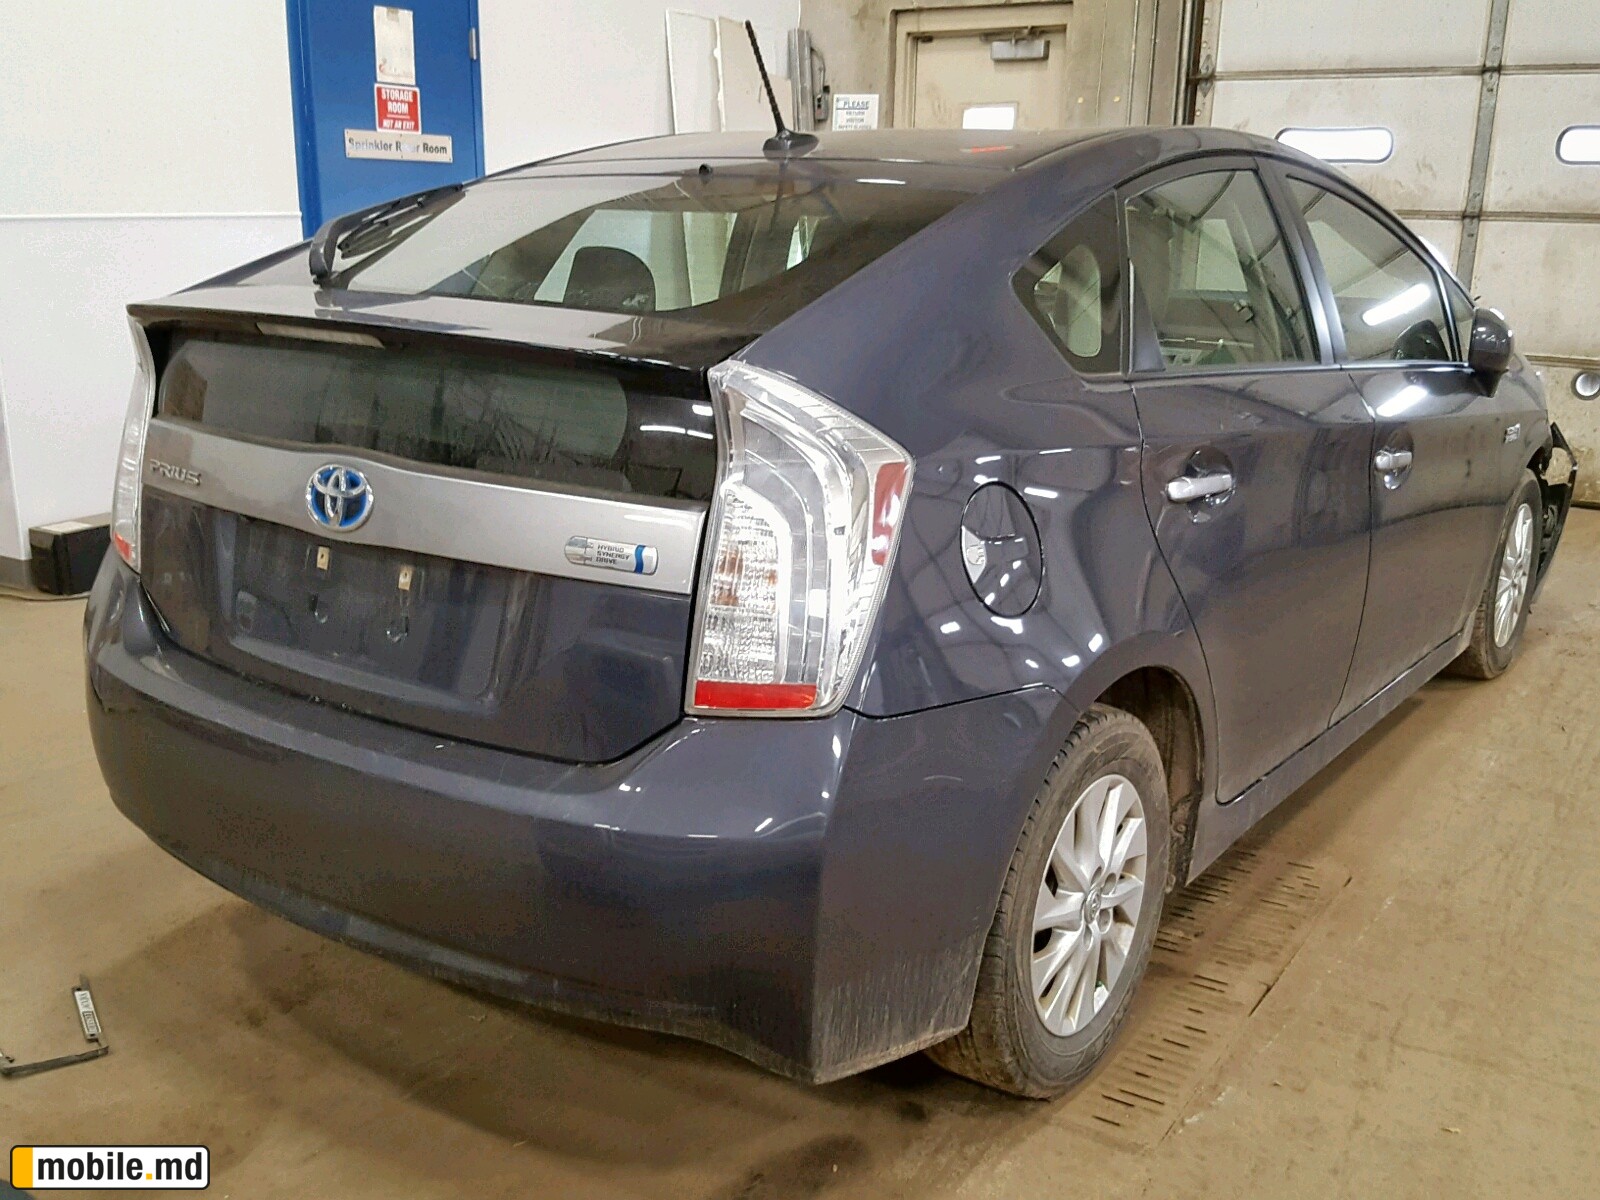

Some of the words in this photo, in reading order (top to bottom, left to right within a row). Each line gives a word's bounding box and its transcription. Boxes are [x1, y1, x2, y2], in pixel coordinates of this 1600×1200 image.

[381, 88, 413, 102] STORAGE
[387, 101, 408, 114] ROOM
[843, 100, 870, 109] PLEASE
[382, 119, 394, 129] NOT
[394, 120, 402, 129] AN
[402, 120, 415, 130] EXIT
[348, 137, 393, 152] Sprinkler
[422, 142, 447, 154] Room
[149, 458, 201, 485] PRIUS
[597, 544, 624, 553] HYBRID
